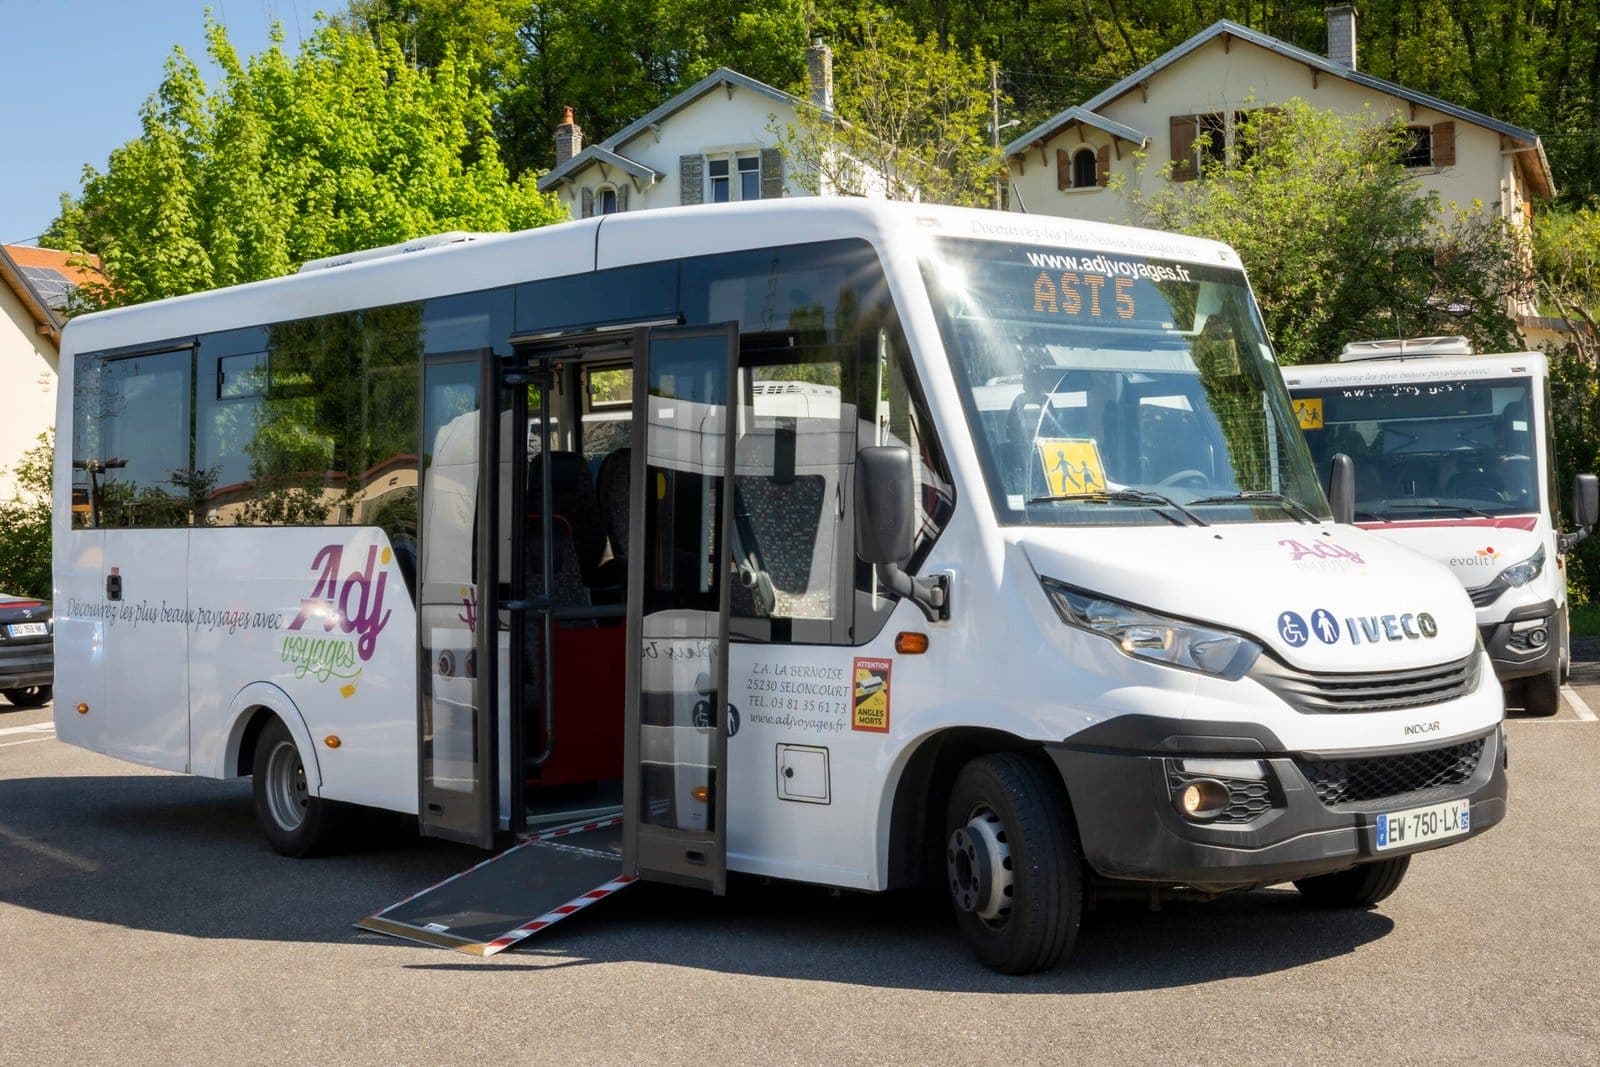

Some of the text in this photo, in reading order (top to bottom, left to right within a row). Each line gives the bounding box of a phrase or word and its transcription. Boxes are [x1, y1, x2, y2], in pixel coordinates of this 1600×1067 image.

[1026, 251, 1191, 283] www.adjvoyages.fr
[1033, 271, 1135, 320] AST 5
[288, 544, 392, 661] Adj
[120, 599, 133, 622] les
[134, 600, 157, 628] plus
[160, 600, 195, 623] beaux
[195, 607, 250, 635] paysages
[252, 612, 282, 630] avec
[1345, 611, 1439, 645] IVECO
[281, 635, 362, 684] voyages
[857, 661, 889, 670] ATTENTION
[752, 662, 844, 680] Z.A. LA BERNOISE
[747, 678, 850, 698] 25230 SELONCOURT
[749, 695, 847, 715] TEL. 03 81 35 61 73
[857, 708, 884, 718] ANGLES
[750, 712, 846, 733] www.adjvoyages.fr
[858, 716, 882, 726] MORTS
